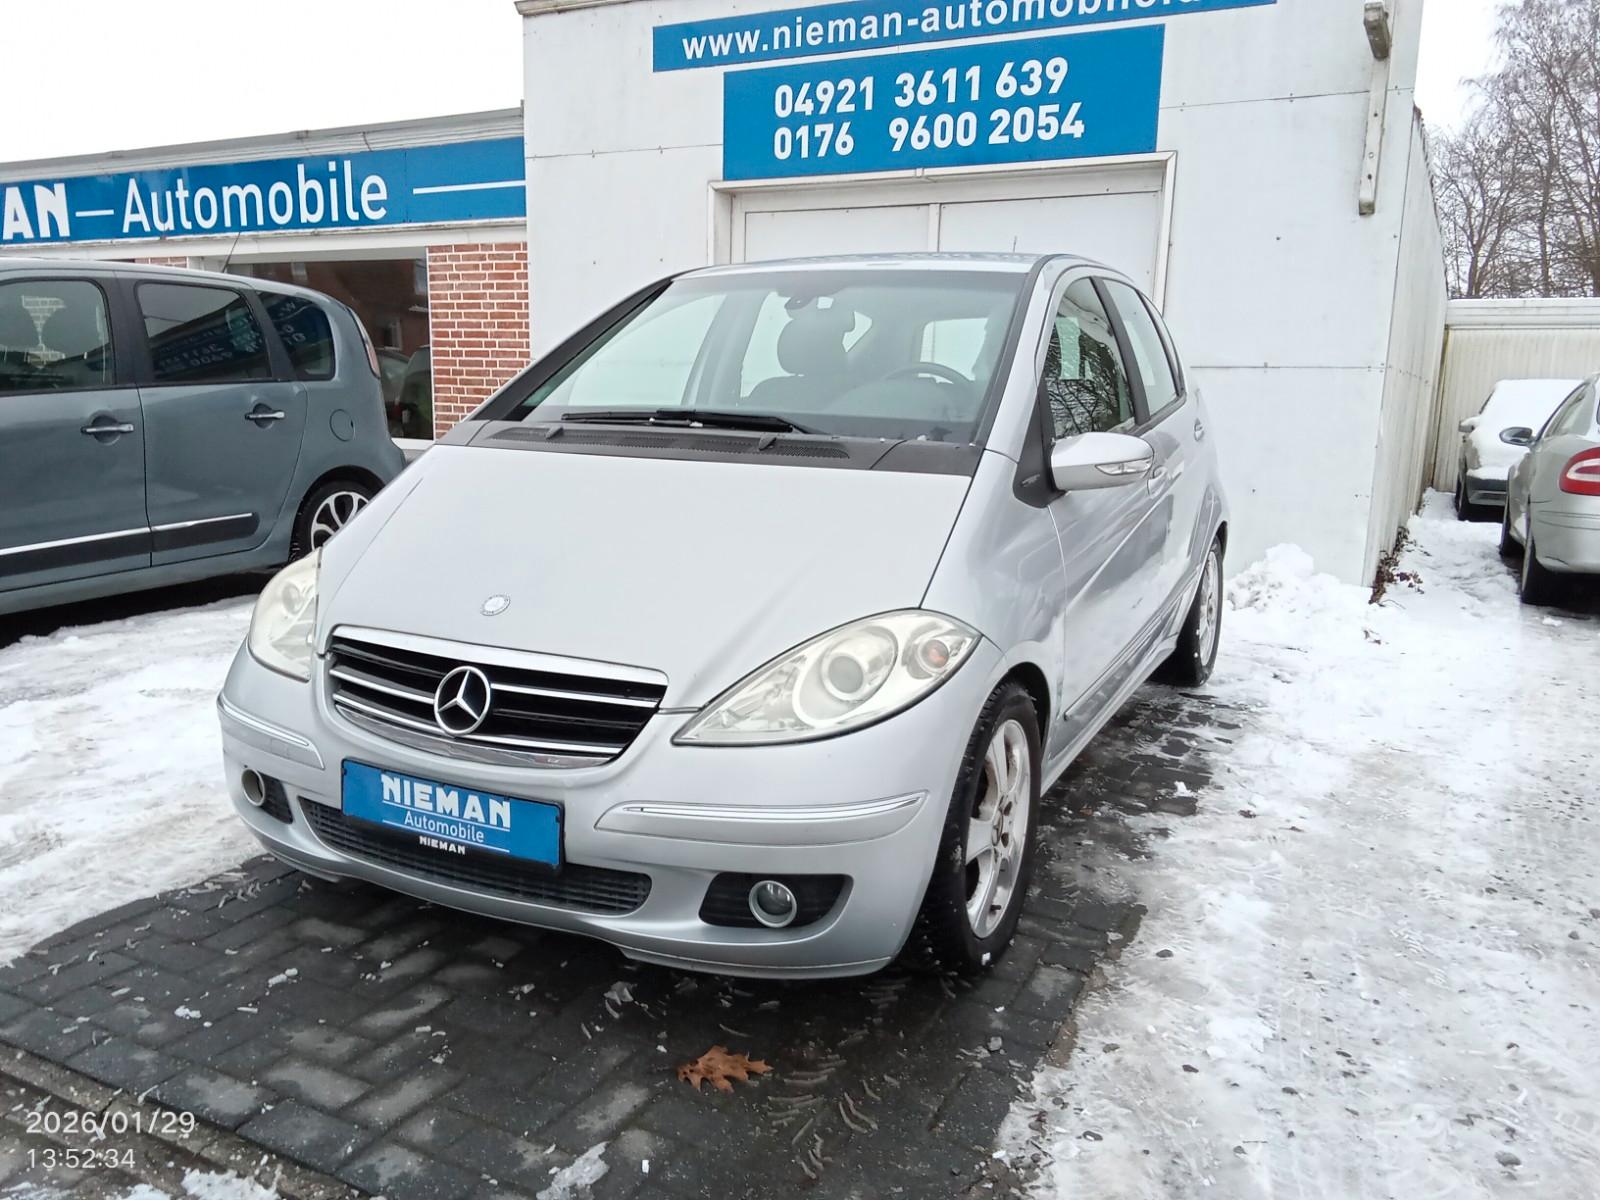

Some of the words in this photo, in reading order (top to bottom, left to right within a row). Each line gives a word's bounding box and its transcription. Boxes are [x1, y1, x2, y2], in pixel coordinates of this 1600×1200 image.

[775, 77, 874, 118] 04921
[895, 66, 981, 107] 3611
[995, 57, 1068, 98] 639
[774, 122, 855, 160] 0176
[888, 112, 978, 152] 9600
[989, 103, 1085, 145] 2054
[2, 183, 71, 240] AN
[122, 160, 388, 233] Automobile
[380, 774, 511, 829] NIEMAN
[404, 811, 485, 843] Automobile
[419, 836, 467, 855] NIEMAN
